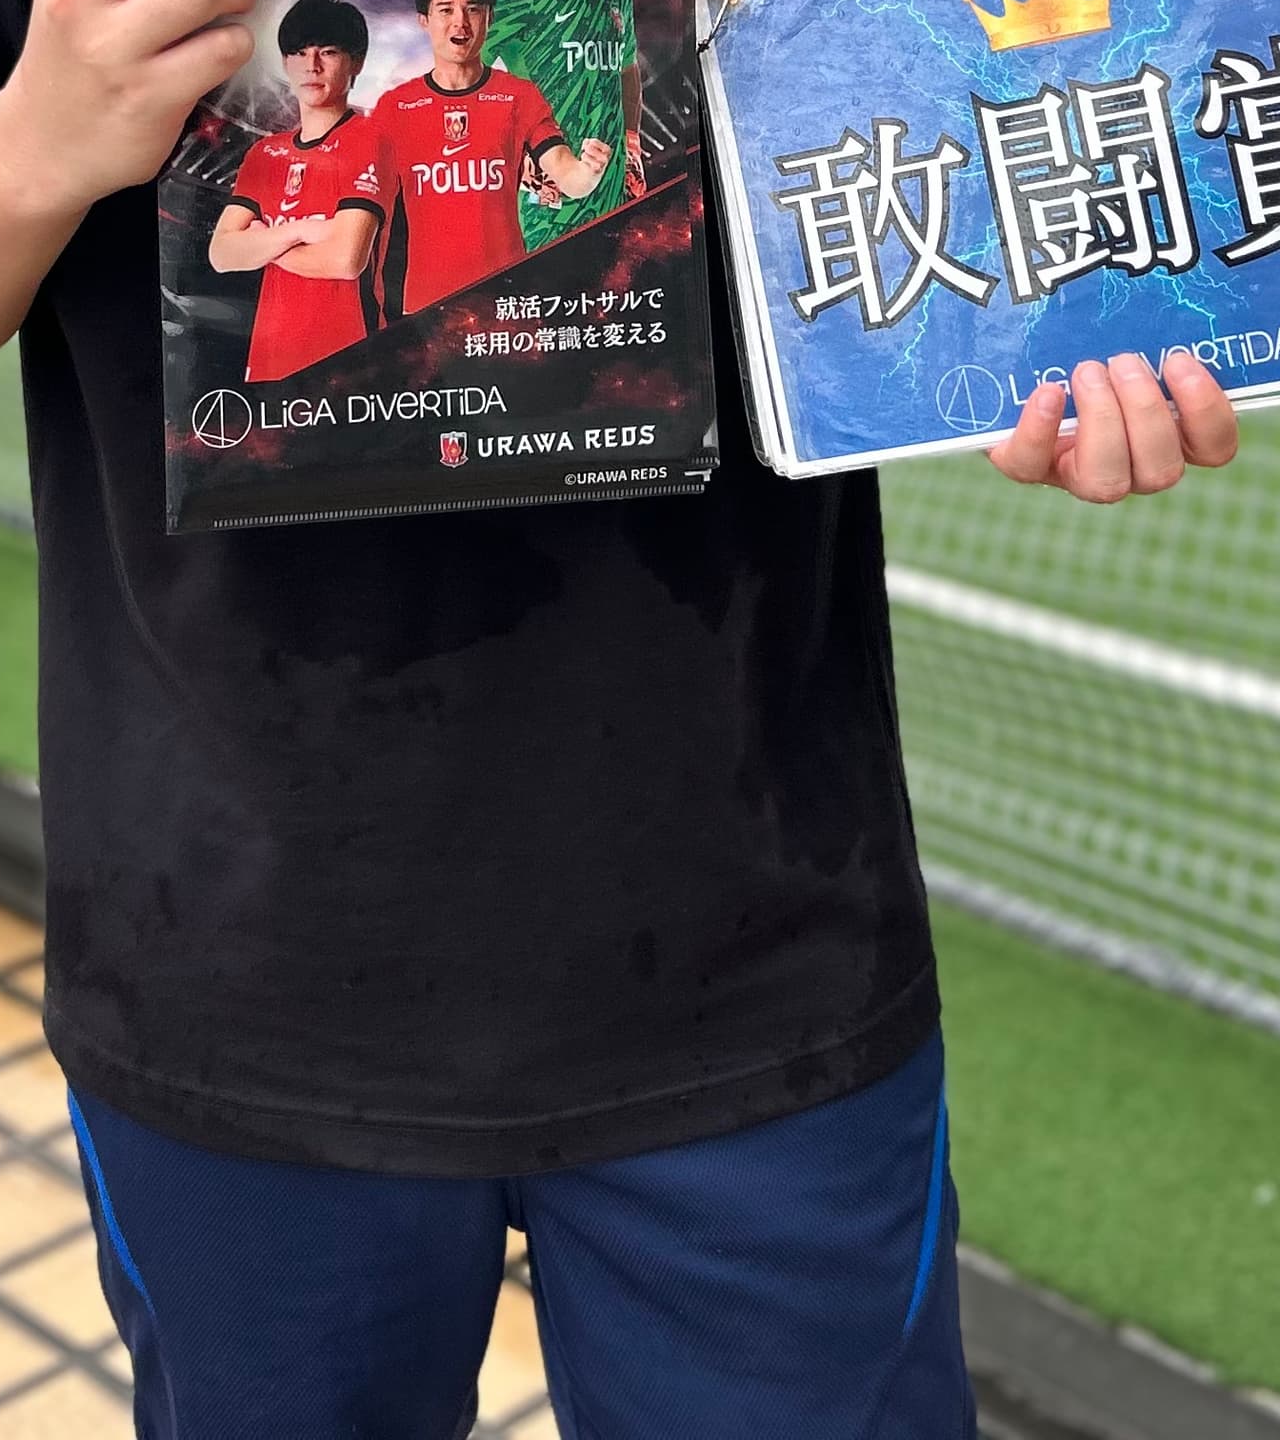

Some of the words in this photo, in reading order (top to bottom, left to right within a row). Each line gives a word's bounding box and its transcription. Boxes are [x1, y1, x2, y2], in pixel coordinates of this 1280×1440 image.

[411, 159, 506, 196] POLUS
[495, 288, 665, 321] 就活フットサルで
[464, 321, 667, 357] 採用の常識を変える
[477, 431, 574, 458] URAWA
[585, 424, 656, 450] REDS
[631, 466, 668, 481] REDS
